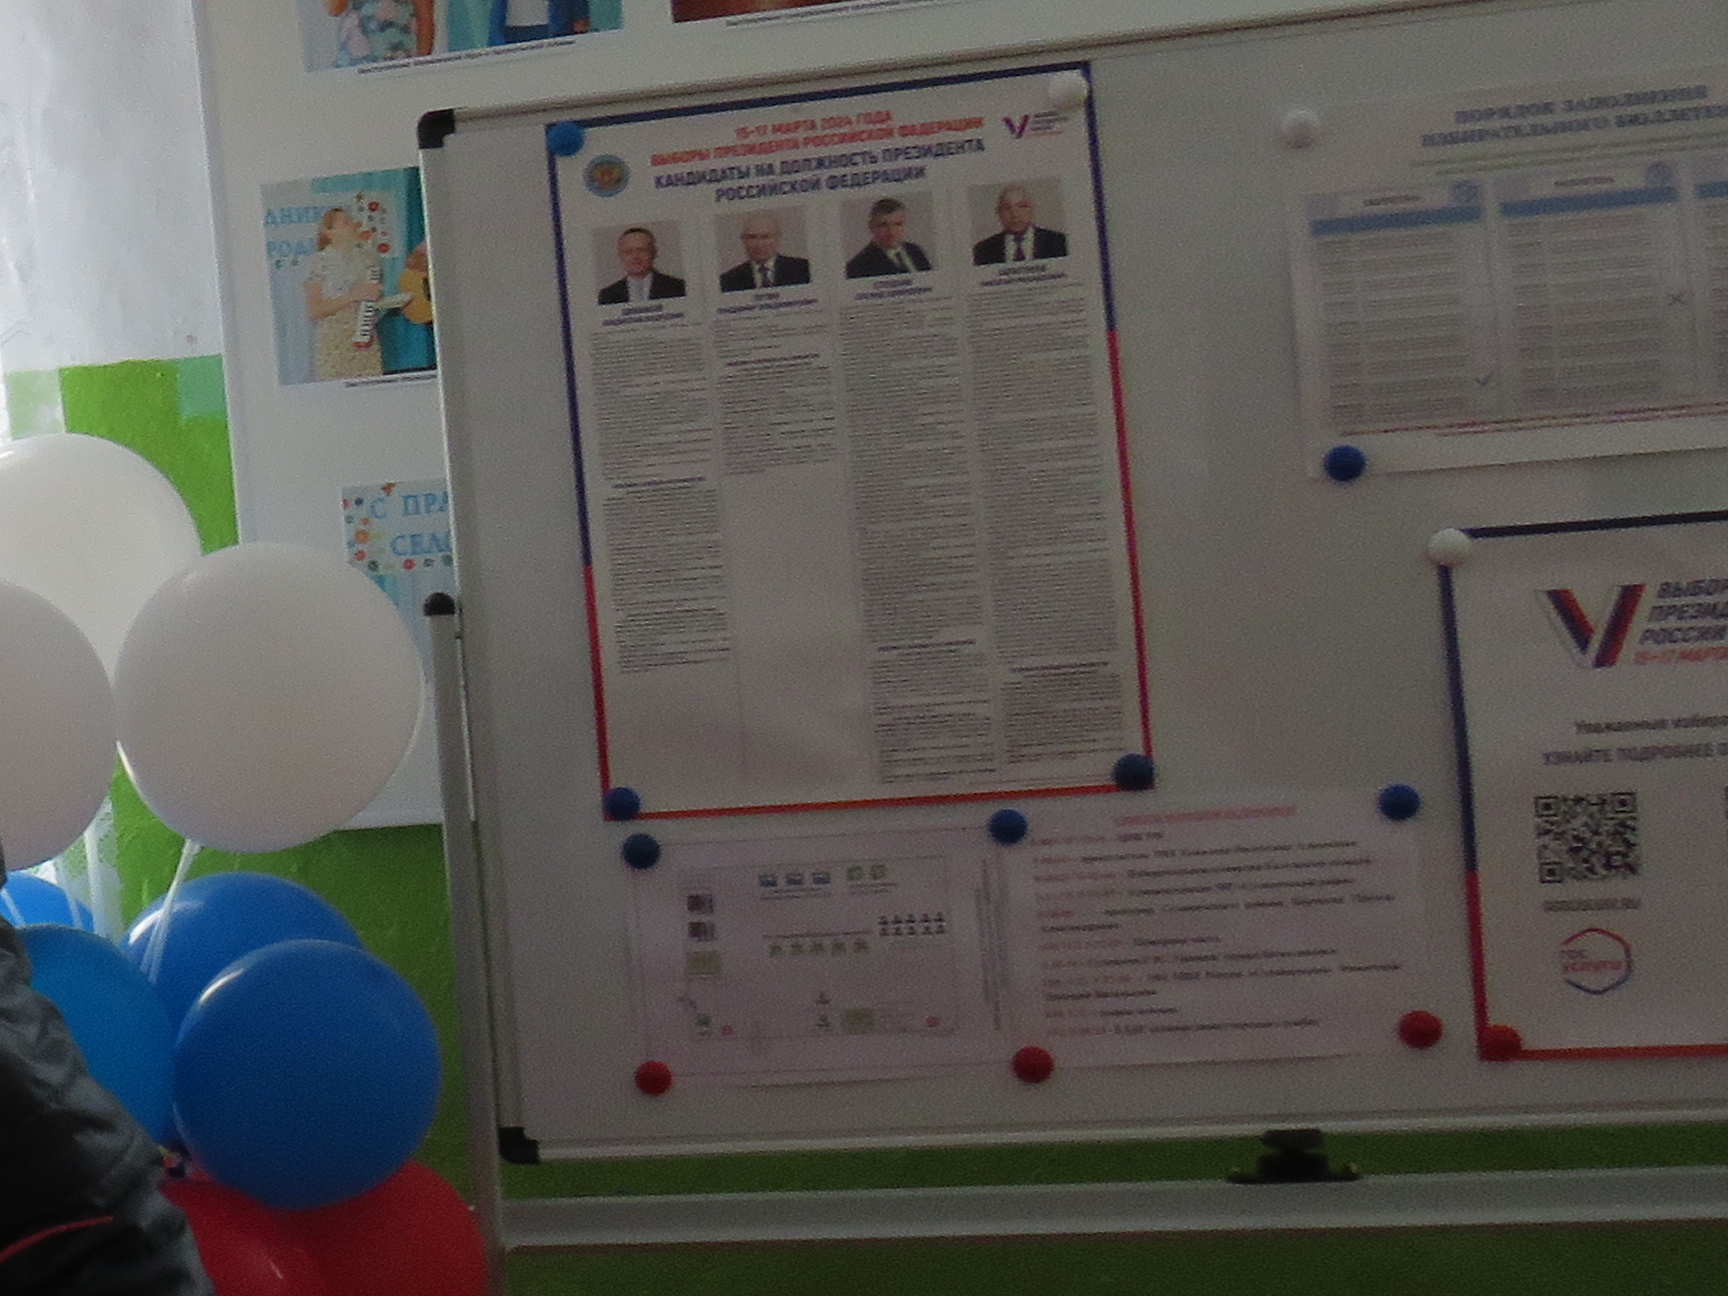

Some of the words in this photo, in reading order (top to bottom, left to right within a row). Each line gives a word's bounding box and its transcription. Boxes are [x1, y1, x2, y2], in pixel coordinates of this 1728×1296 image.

[653, 166, 752, 190] КАНДИДАТЫ
[754, 161, 776, 179] НА
[778, 149, 879, 177] ДОЛЖНОСТЬ
[881, 137, 987, 163] ПРЕЗИДЕНТА
[714, 179, 823, 203] РОССИЙСКОЙ
[825, 165, 928, 191] ФЕДЕРАЦИИ
